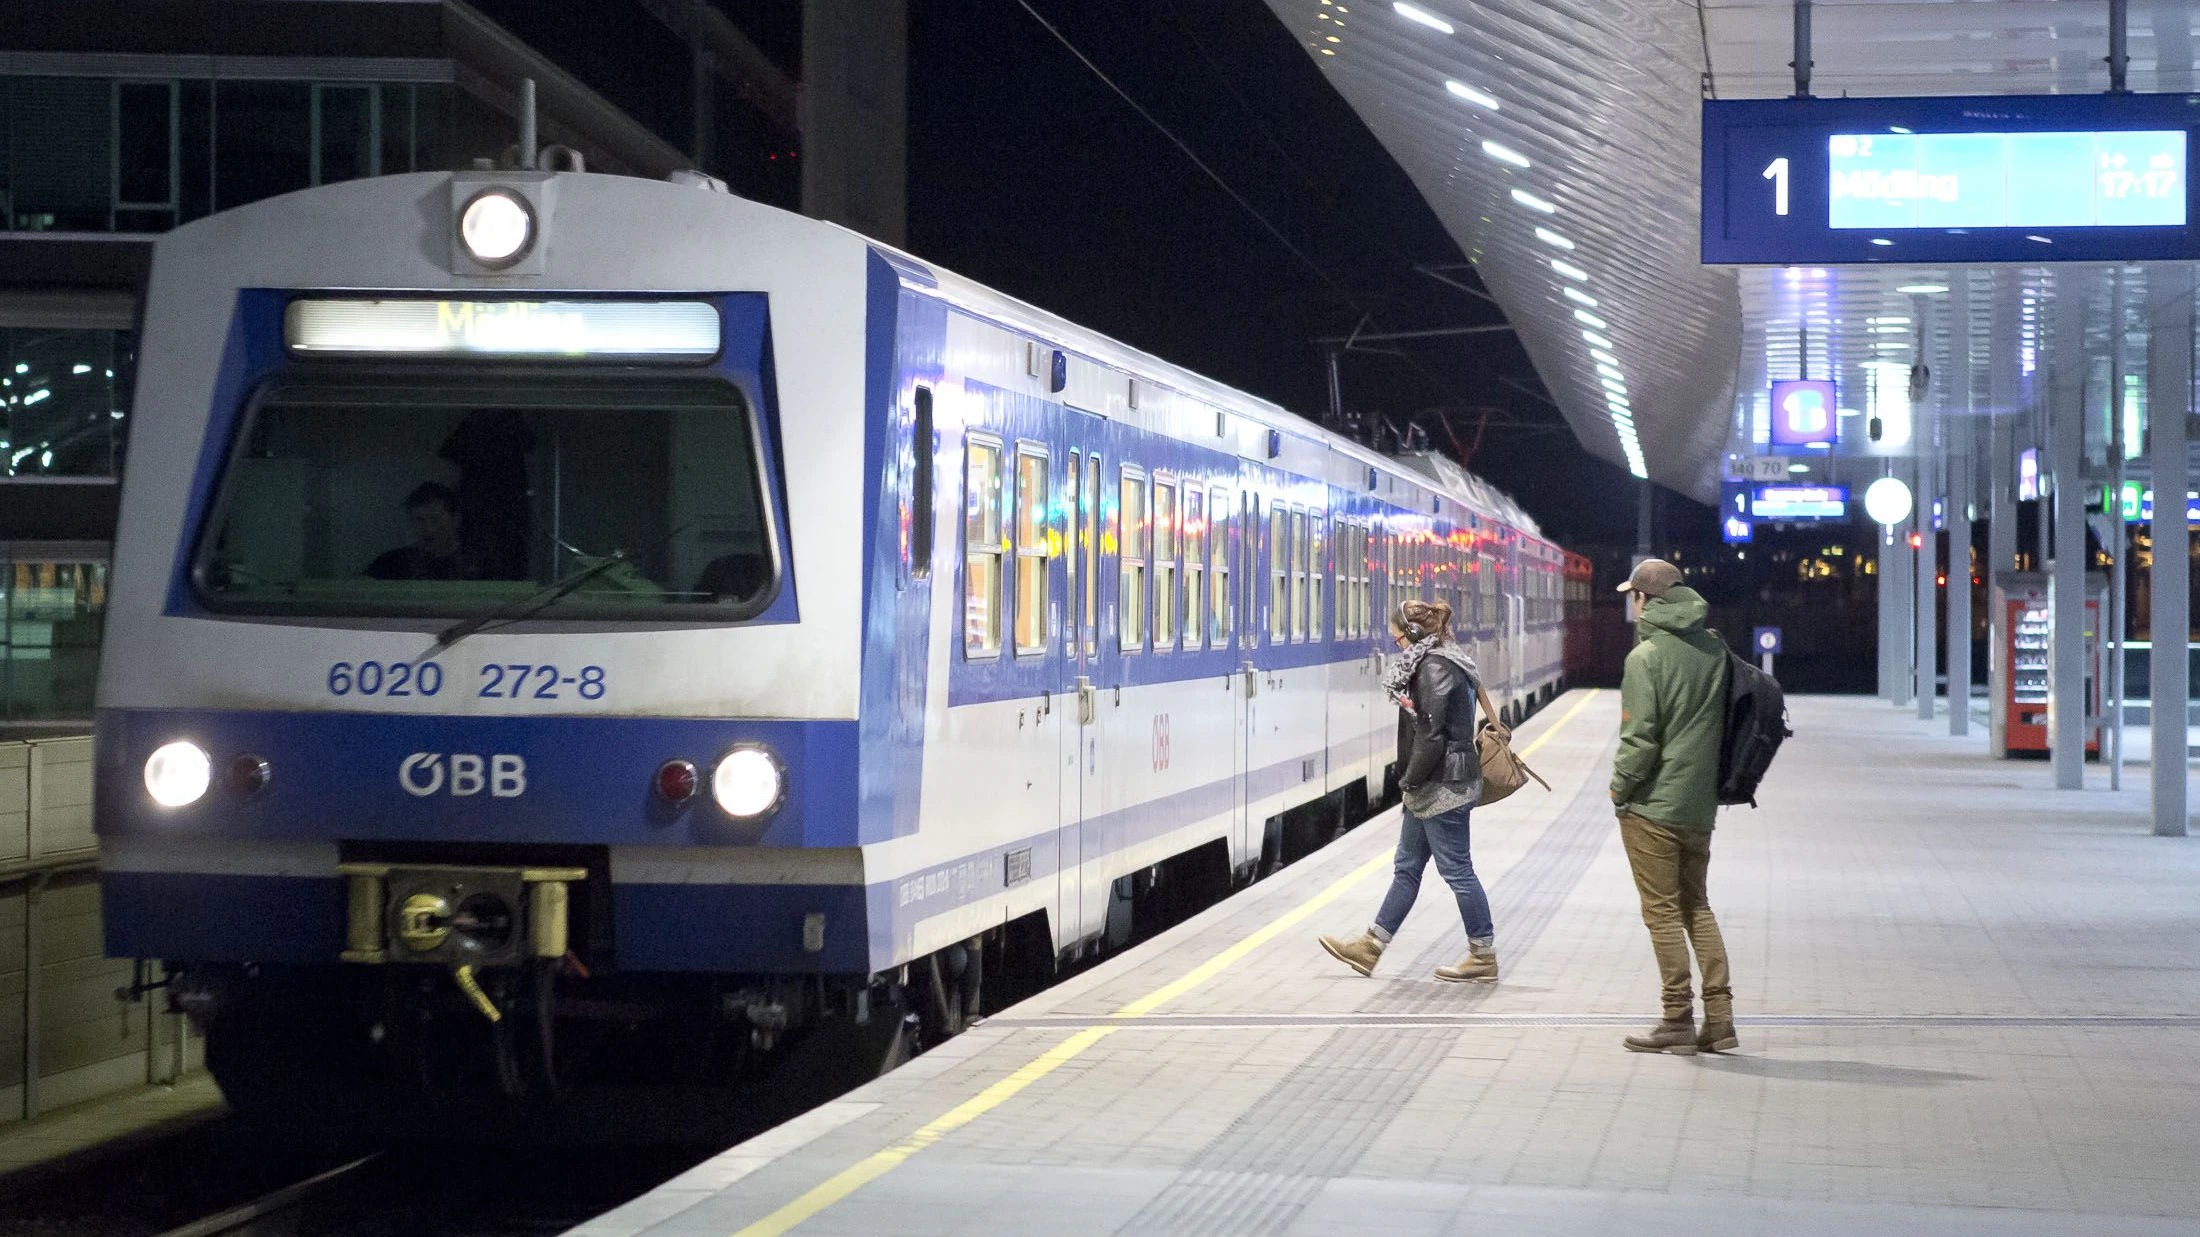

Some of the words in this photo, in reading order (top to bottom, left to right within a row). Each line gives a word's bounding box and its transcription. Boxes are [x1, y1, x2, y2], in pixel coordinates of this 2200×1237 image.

[1762, 157, 1789, 216] 1
[2099, 170, 2177, 199] 17:17
[1762, 461, 1781, 475] 70
[1734, 493, 1745, 512] 1
[328, 660, 443, 697] 6020
[479, 663, 605, 700] 272-8
[398, 751, 527, 798] ÖBB
